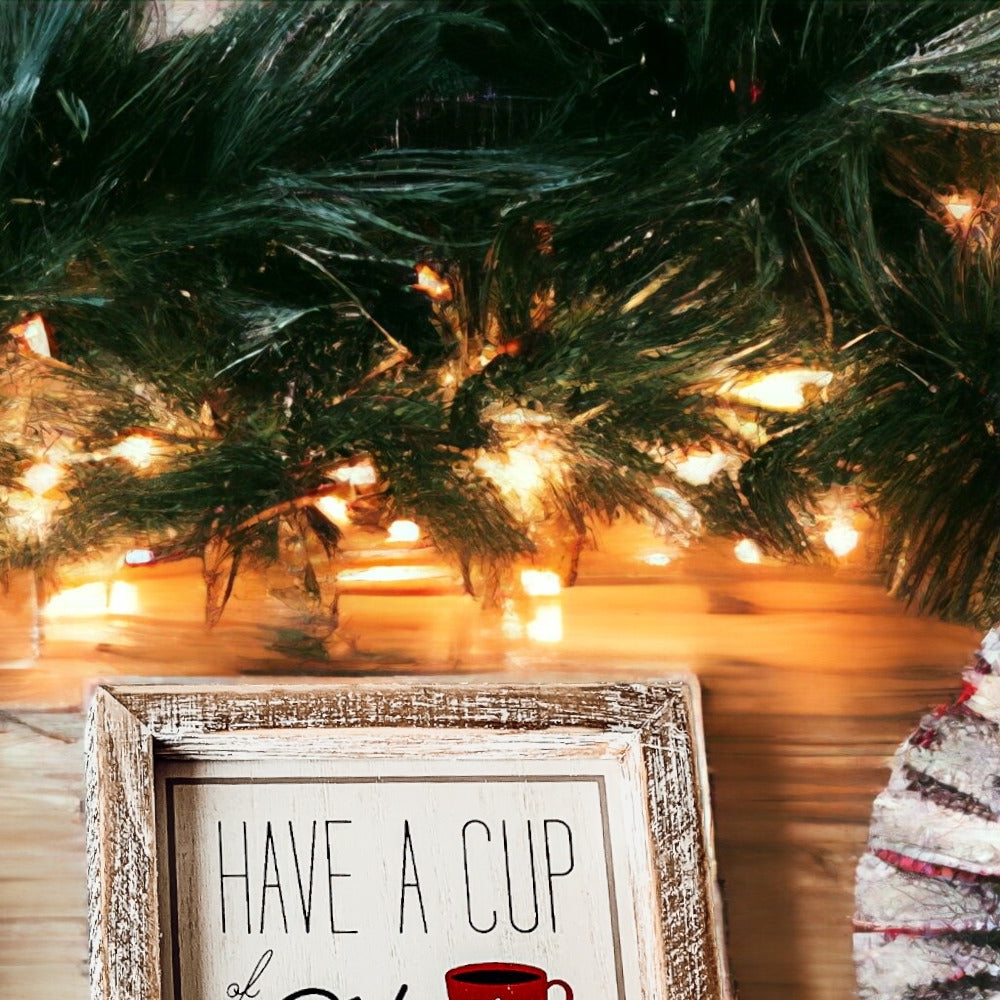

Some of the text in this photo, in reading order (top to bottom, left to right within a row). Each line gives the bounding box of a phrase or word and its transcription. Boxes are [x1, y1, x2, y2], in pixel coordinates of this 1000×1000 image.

[217, 818, 575, 935] HAVE A CUP
